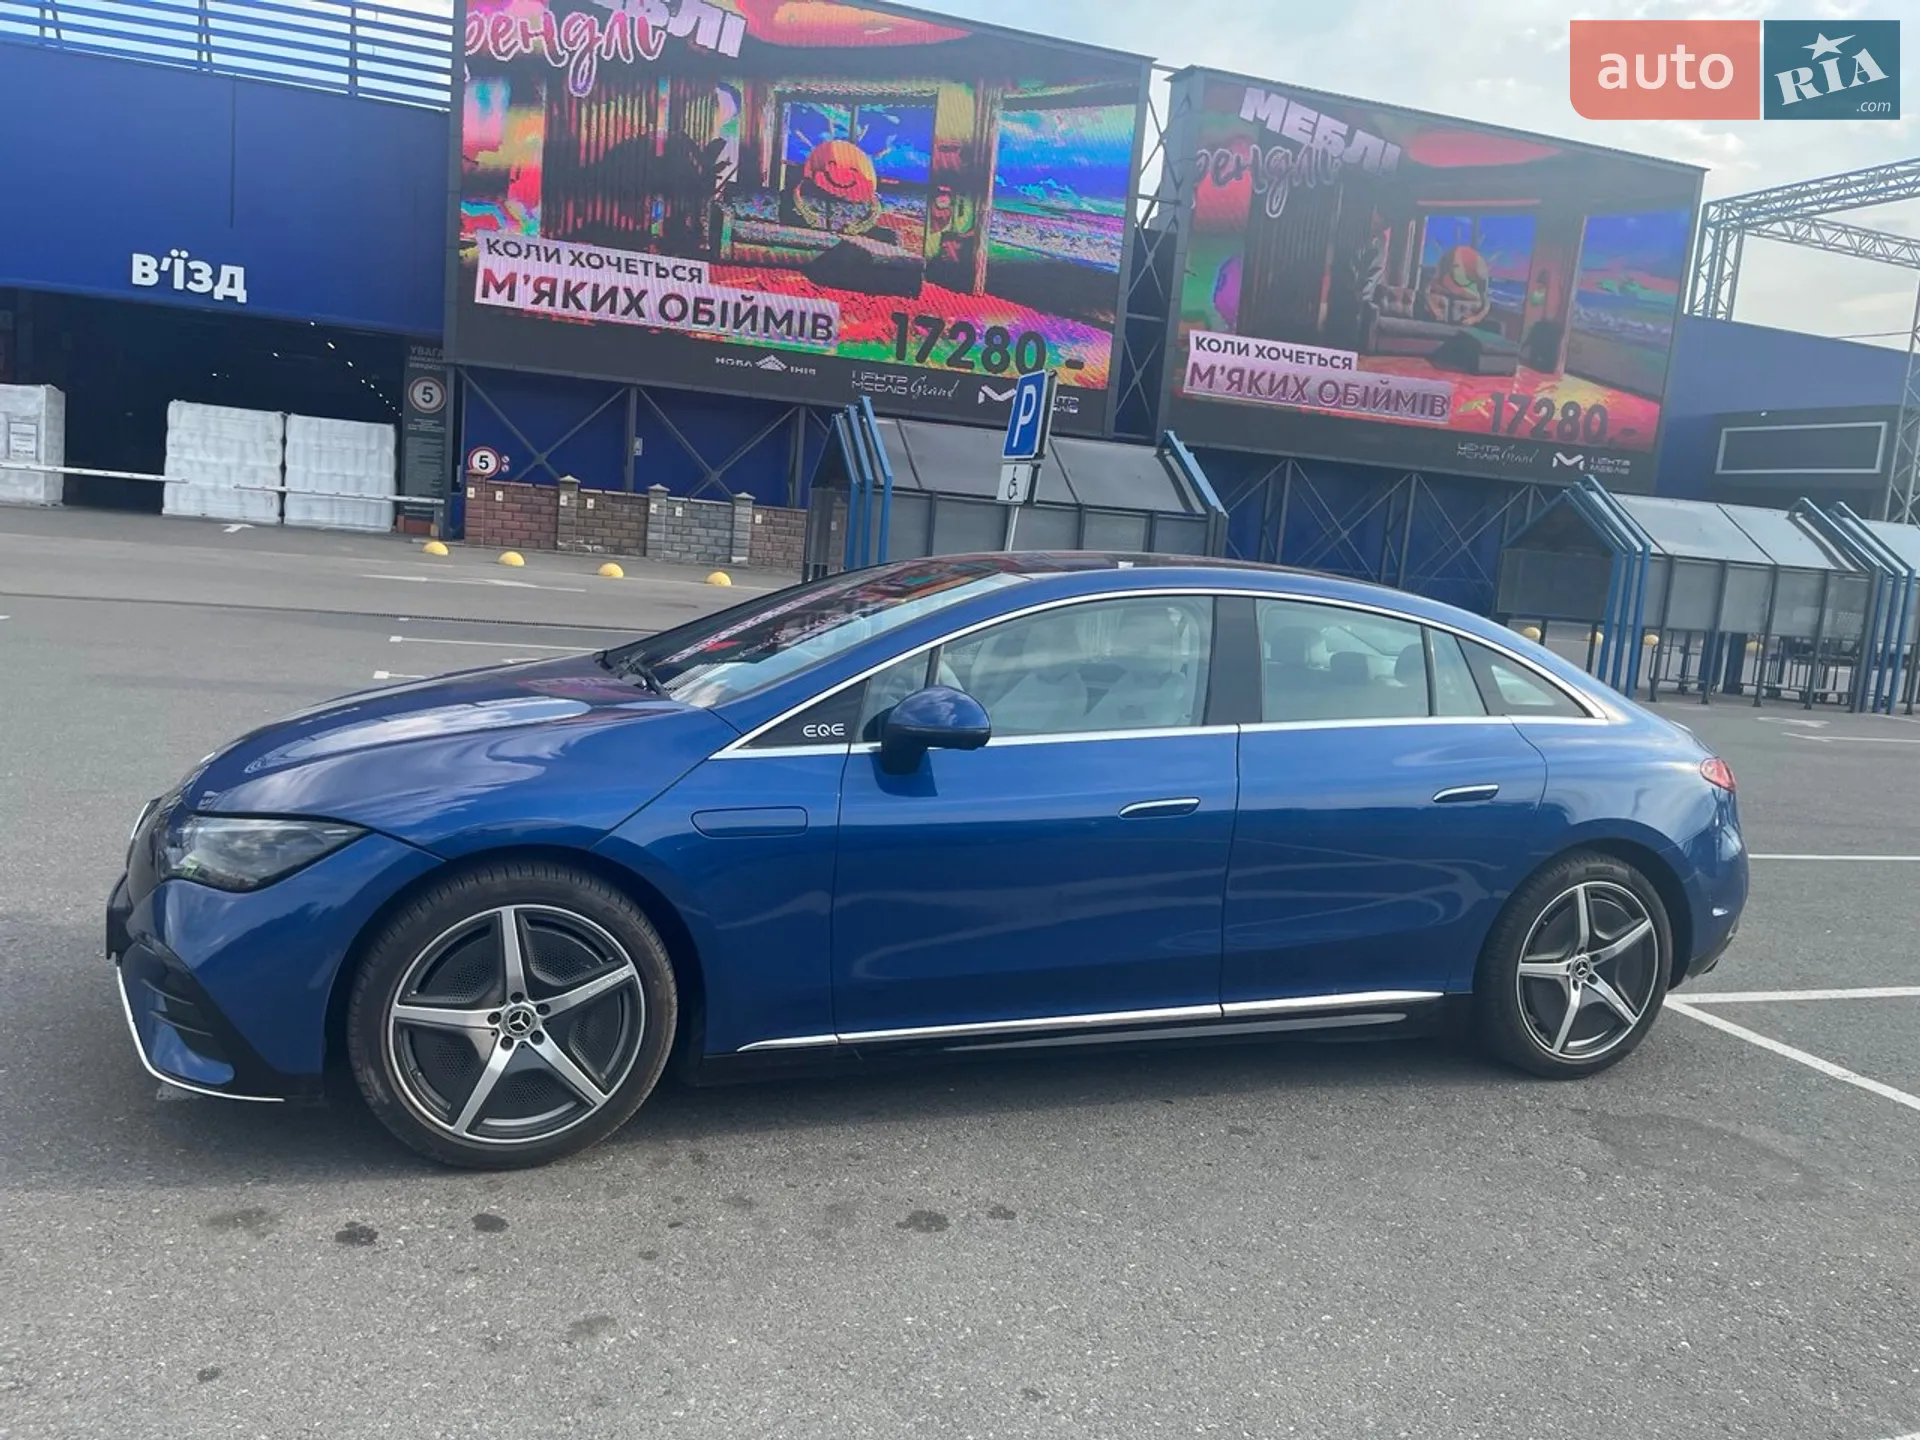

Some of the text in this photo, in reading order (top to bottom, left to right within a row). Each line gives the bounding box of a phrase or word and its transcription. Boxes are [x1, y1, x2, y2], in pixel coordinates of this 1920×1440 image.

[1239, 86, 1401, 177] МЕБЛІ
[131, 248, 248, 304] В'ЇЗД
[485, 237, 703, 284] КОЛИ ХОЧЕТЬСЯ
[480, 267, 834, 343] М'ЯКИХ ОБІЙМІВ
[1195, 336, 1353, 371] КОЛИ ХОЧЕТЬСЯ
[422, 386, 434, 404] 5
[1012, 384, 1037, 448] P
[1188, 362, 1450, 420] М'ЯКИХ ОБІЙМІВ
[479, 455, 489, 470] 5
[803, 723, 845, 737] EQE
